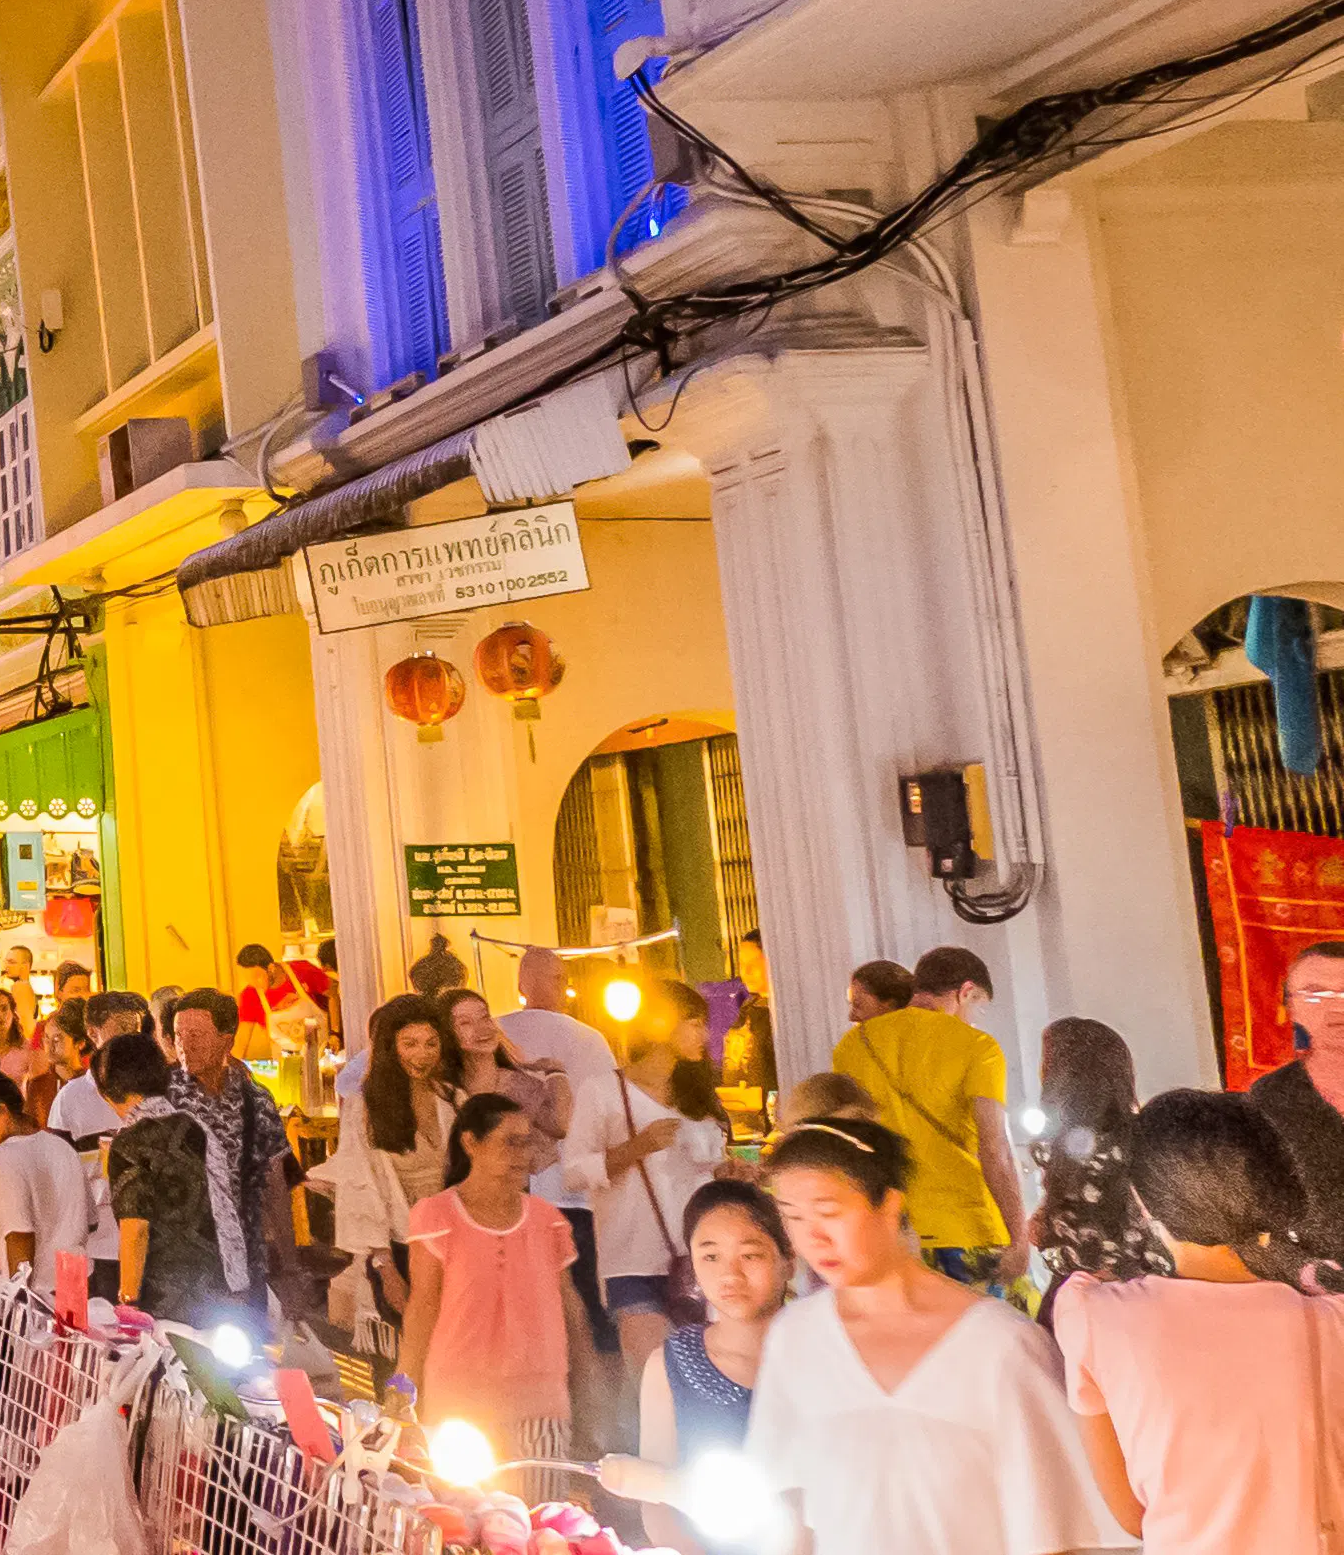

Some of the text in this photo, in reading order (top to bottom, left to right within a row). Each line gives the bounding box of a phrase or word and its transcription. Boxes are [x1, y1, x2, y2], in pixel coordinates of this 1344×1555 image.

[319, 513, 571, 596] ภูเก็ตการแพทย์คลินิก
